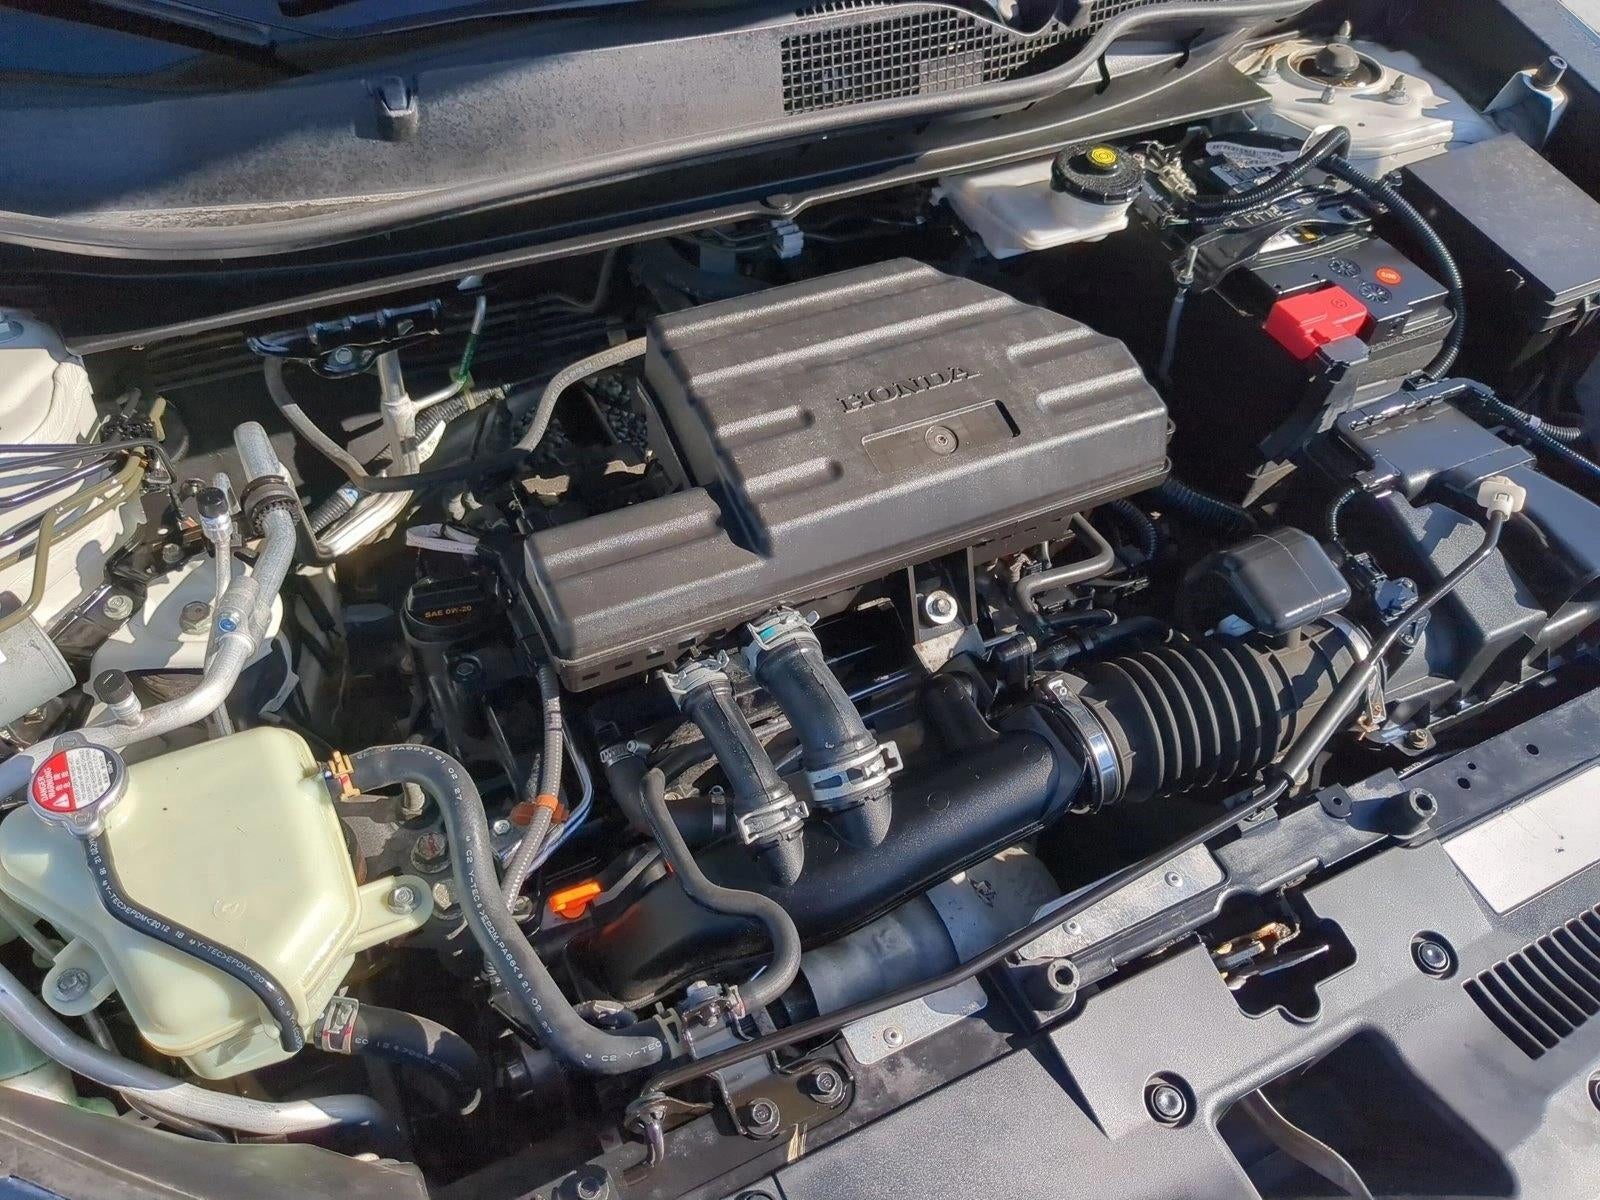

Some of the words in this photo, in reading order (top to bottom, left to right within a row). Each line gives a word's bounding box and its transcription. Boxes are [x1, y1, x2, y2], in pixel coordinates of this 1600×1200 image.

[836, 366, 981, 413] HONDA
[424, 610, 443, 618] SAE
[445, 605, 472, 615] 0W-20
[448, 767, 459, 781] 02
[468, 869, 480, 902] Y-TEC
[531, 998, 542, 1013] 02
[625, 1040, 662, 1058] Y-TEC
